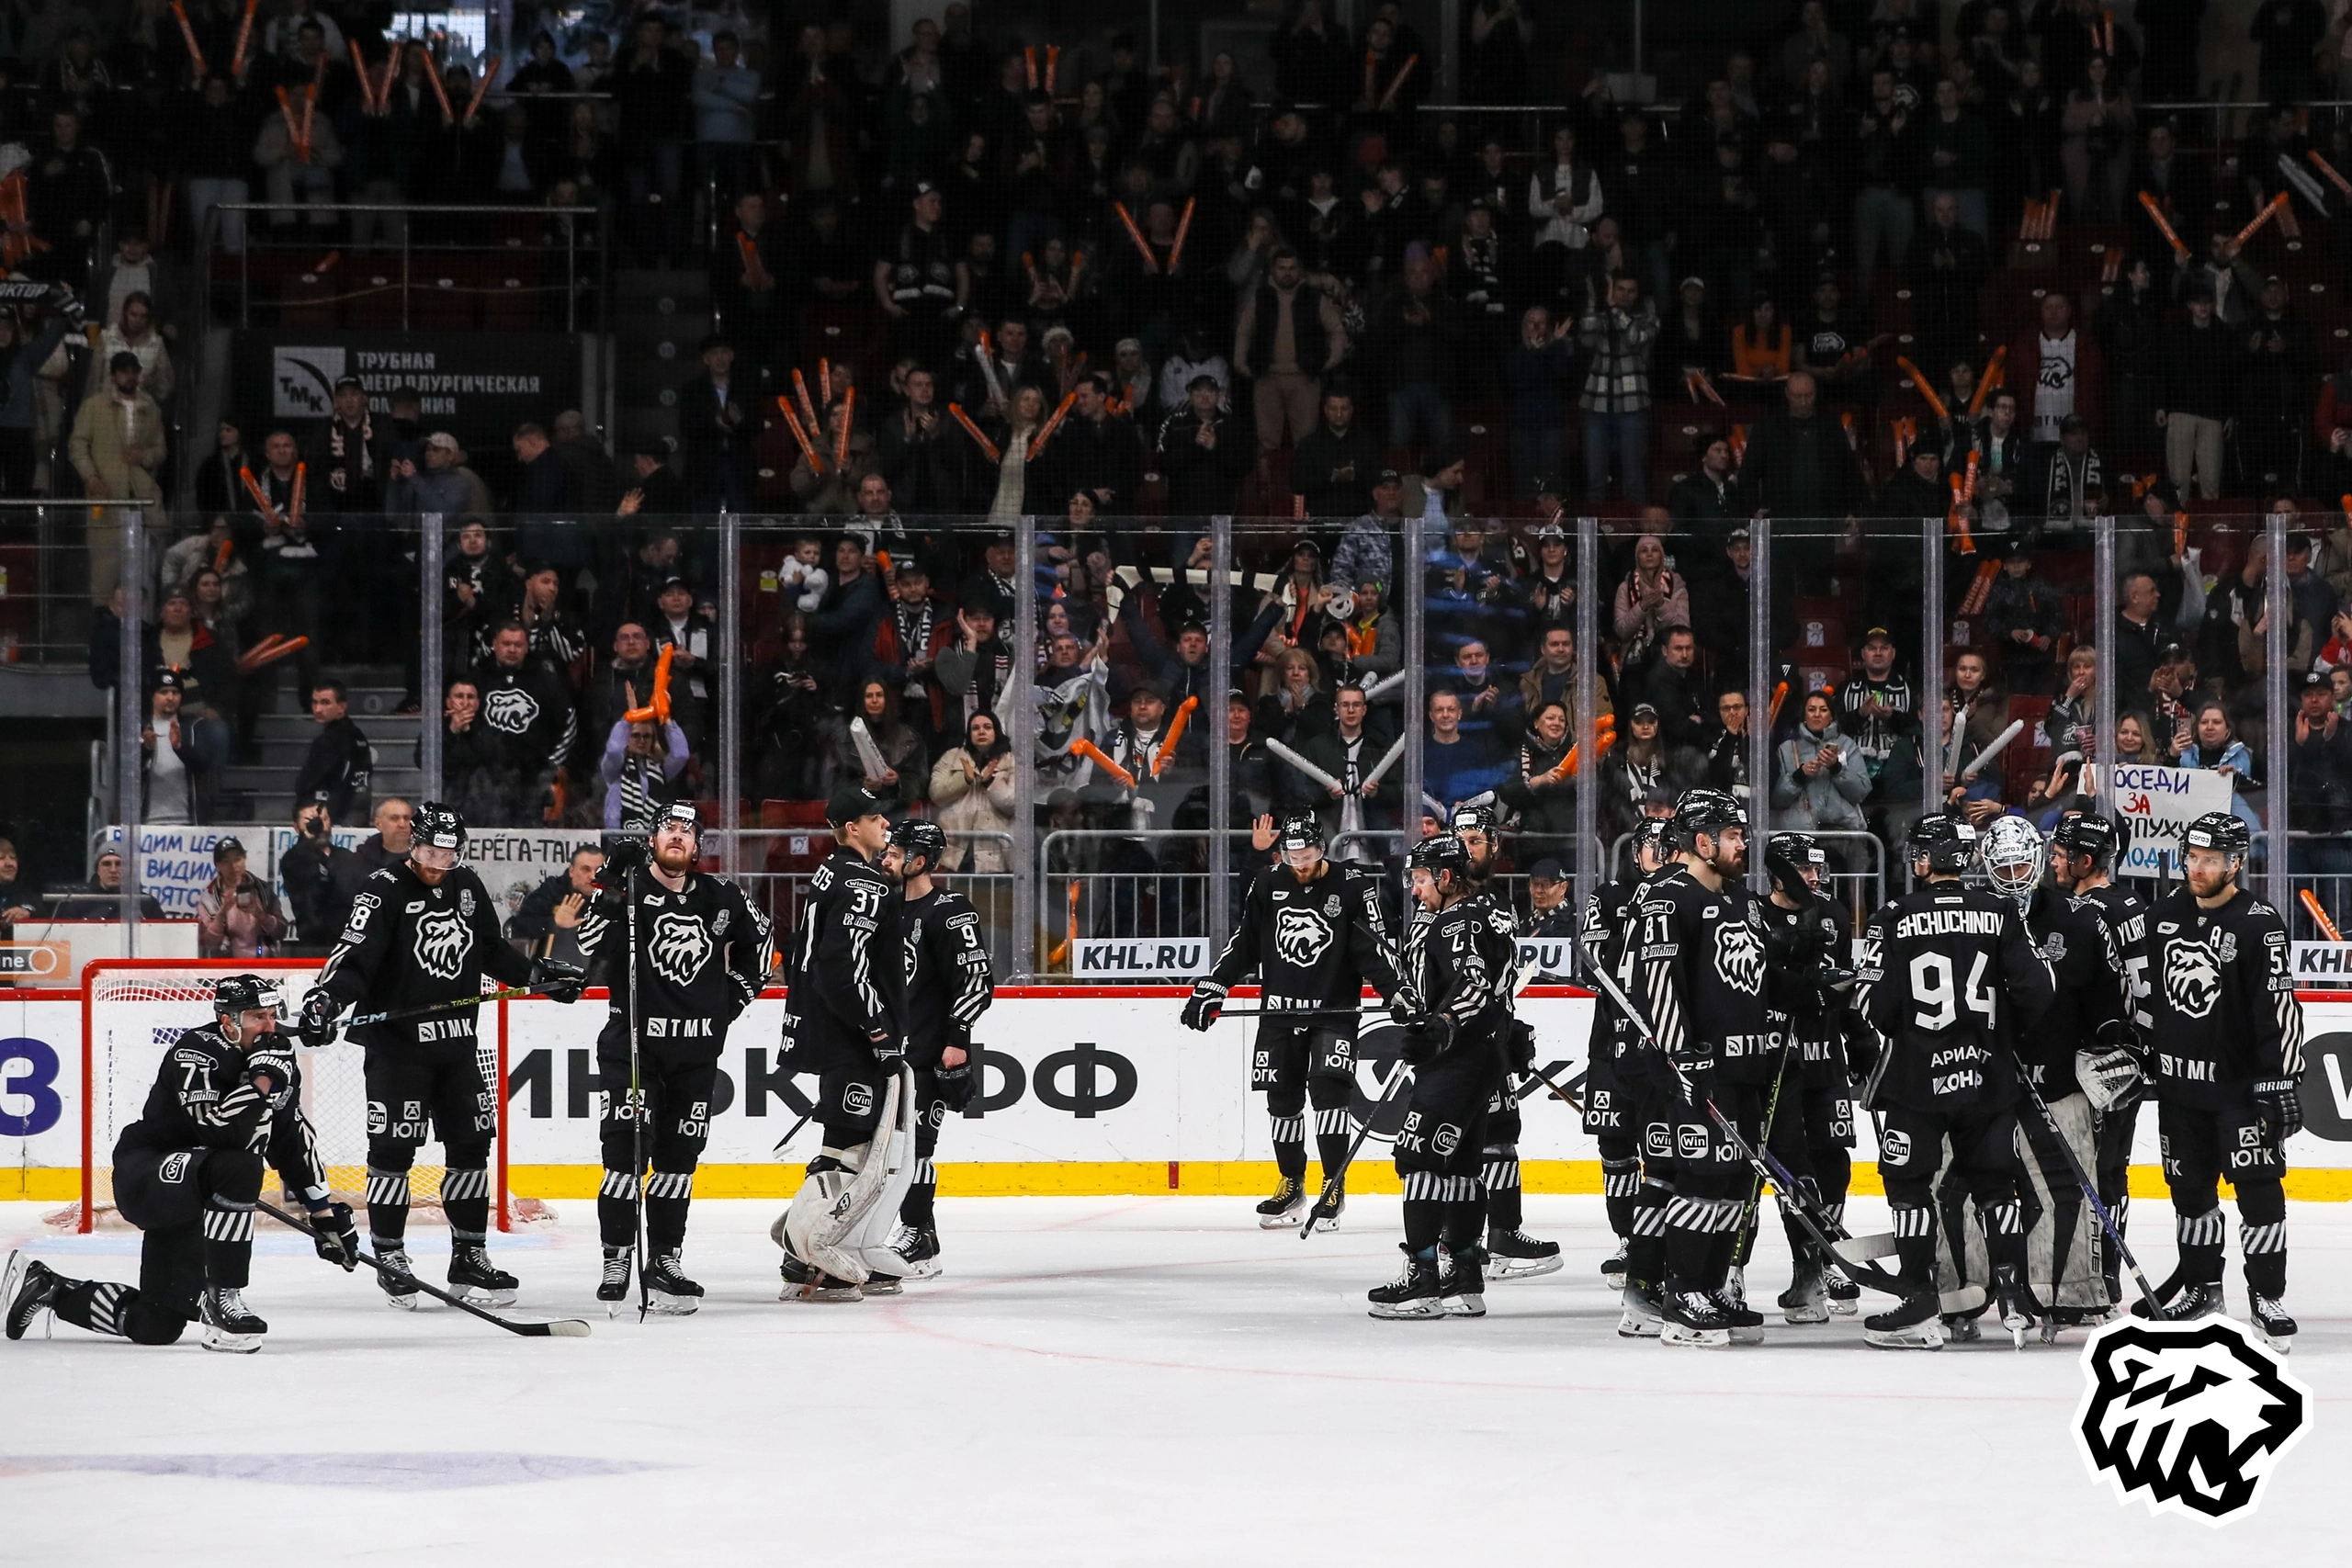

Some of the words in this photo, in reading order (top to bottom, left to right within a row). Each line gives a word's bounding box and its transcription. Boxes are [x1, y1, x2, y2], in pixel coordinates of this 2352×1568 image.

[356, 352, 436, 370] ТРУБНАЯ
[277, 377, 324, 413] ТМК
[2114, 768, 2189, 795] ОСЕДИ
[2122, 791, 2152, 815] ЗА
[437, 811, 454, 823] 28
[1288, 821, 1301, 832] 98
[435, 837, 454, 845] согаз
[2189, 832, 2209, 843] согаз
[1997, 846, 2019, 854] согаз
[1955, 853, 1970, 868] 94
[851, 888, 880, 918] 31
[960, 923, 976, 948] 9
[1644, 915, 1669, 944] 81
[1896, 913, 2005, 939] SHCHUCHINOV
[2209, 925, 2222, 948] A
[1081, 944, 1202, 970] KHL.RU
[250, 979, 267, 988] 71
[1909, 951, 1996, 1031] 94
[450, 997, 481, 1007] TACKS
[336, 1011, 388, 1029] CCM
[435, 1018, 475, 1040] ТМК
[671, 1018, 714, 1039] ТМК
[181, 1052, 208, 1064] Winline
[178, 1062, 211, 1091] 71
[2174, 1057, 2218, 1084] ТМК
[851, 1093, 871, 1108] Win
[1585, 1110, 1622, 1129] ЮГК
[392, 1122, 427, 1139] ЮГК
[1681, 1135, 1705, 1147] Win
[1887, 1141, 1909, 1155] Win
[2230, 1147, 2276, 1169] ЮГК
